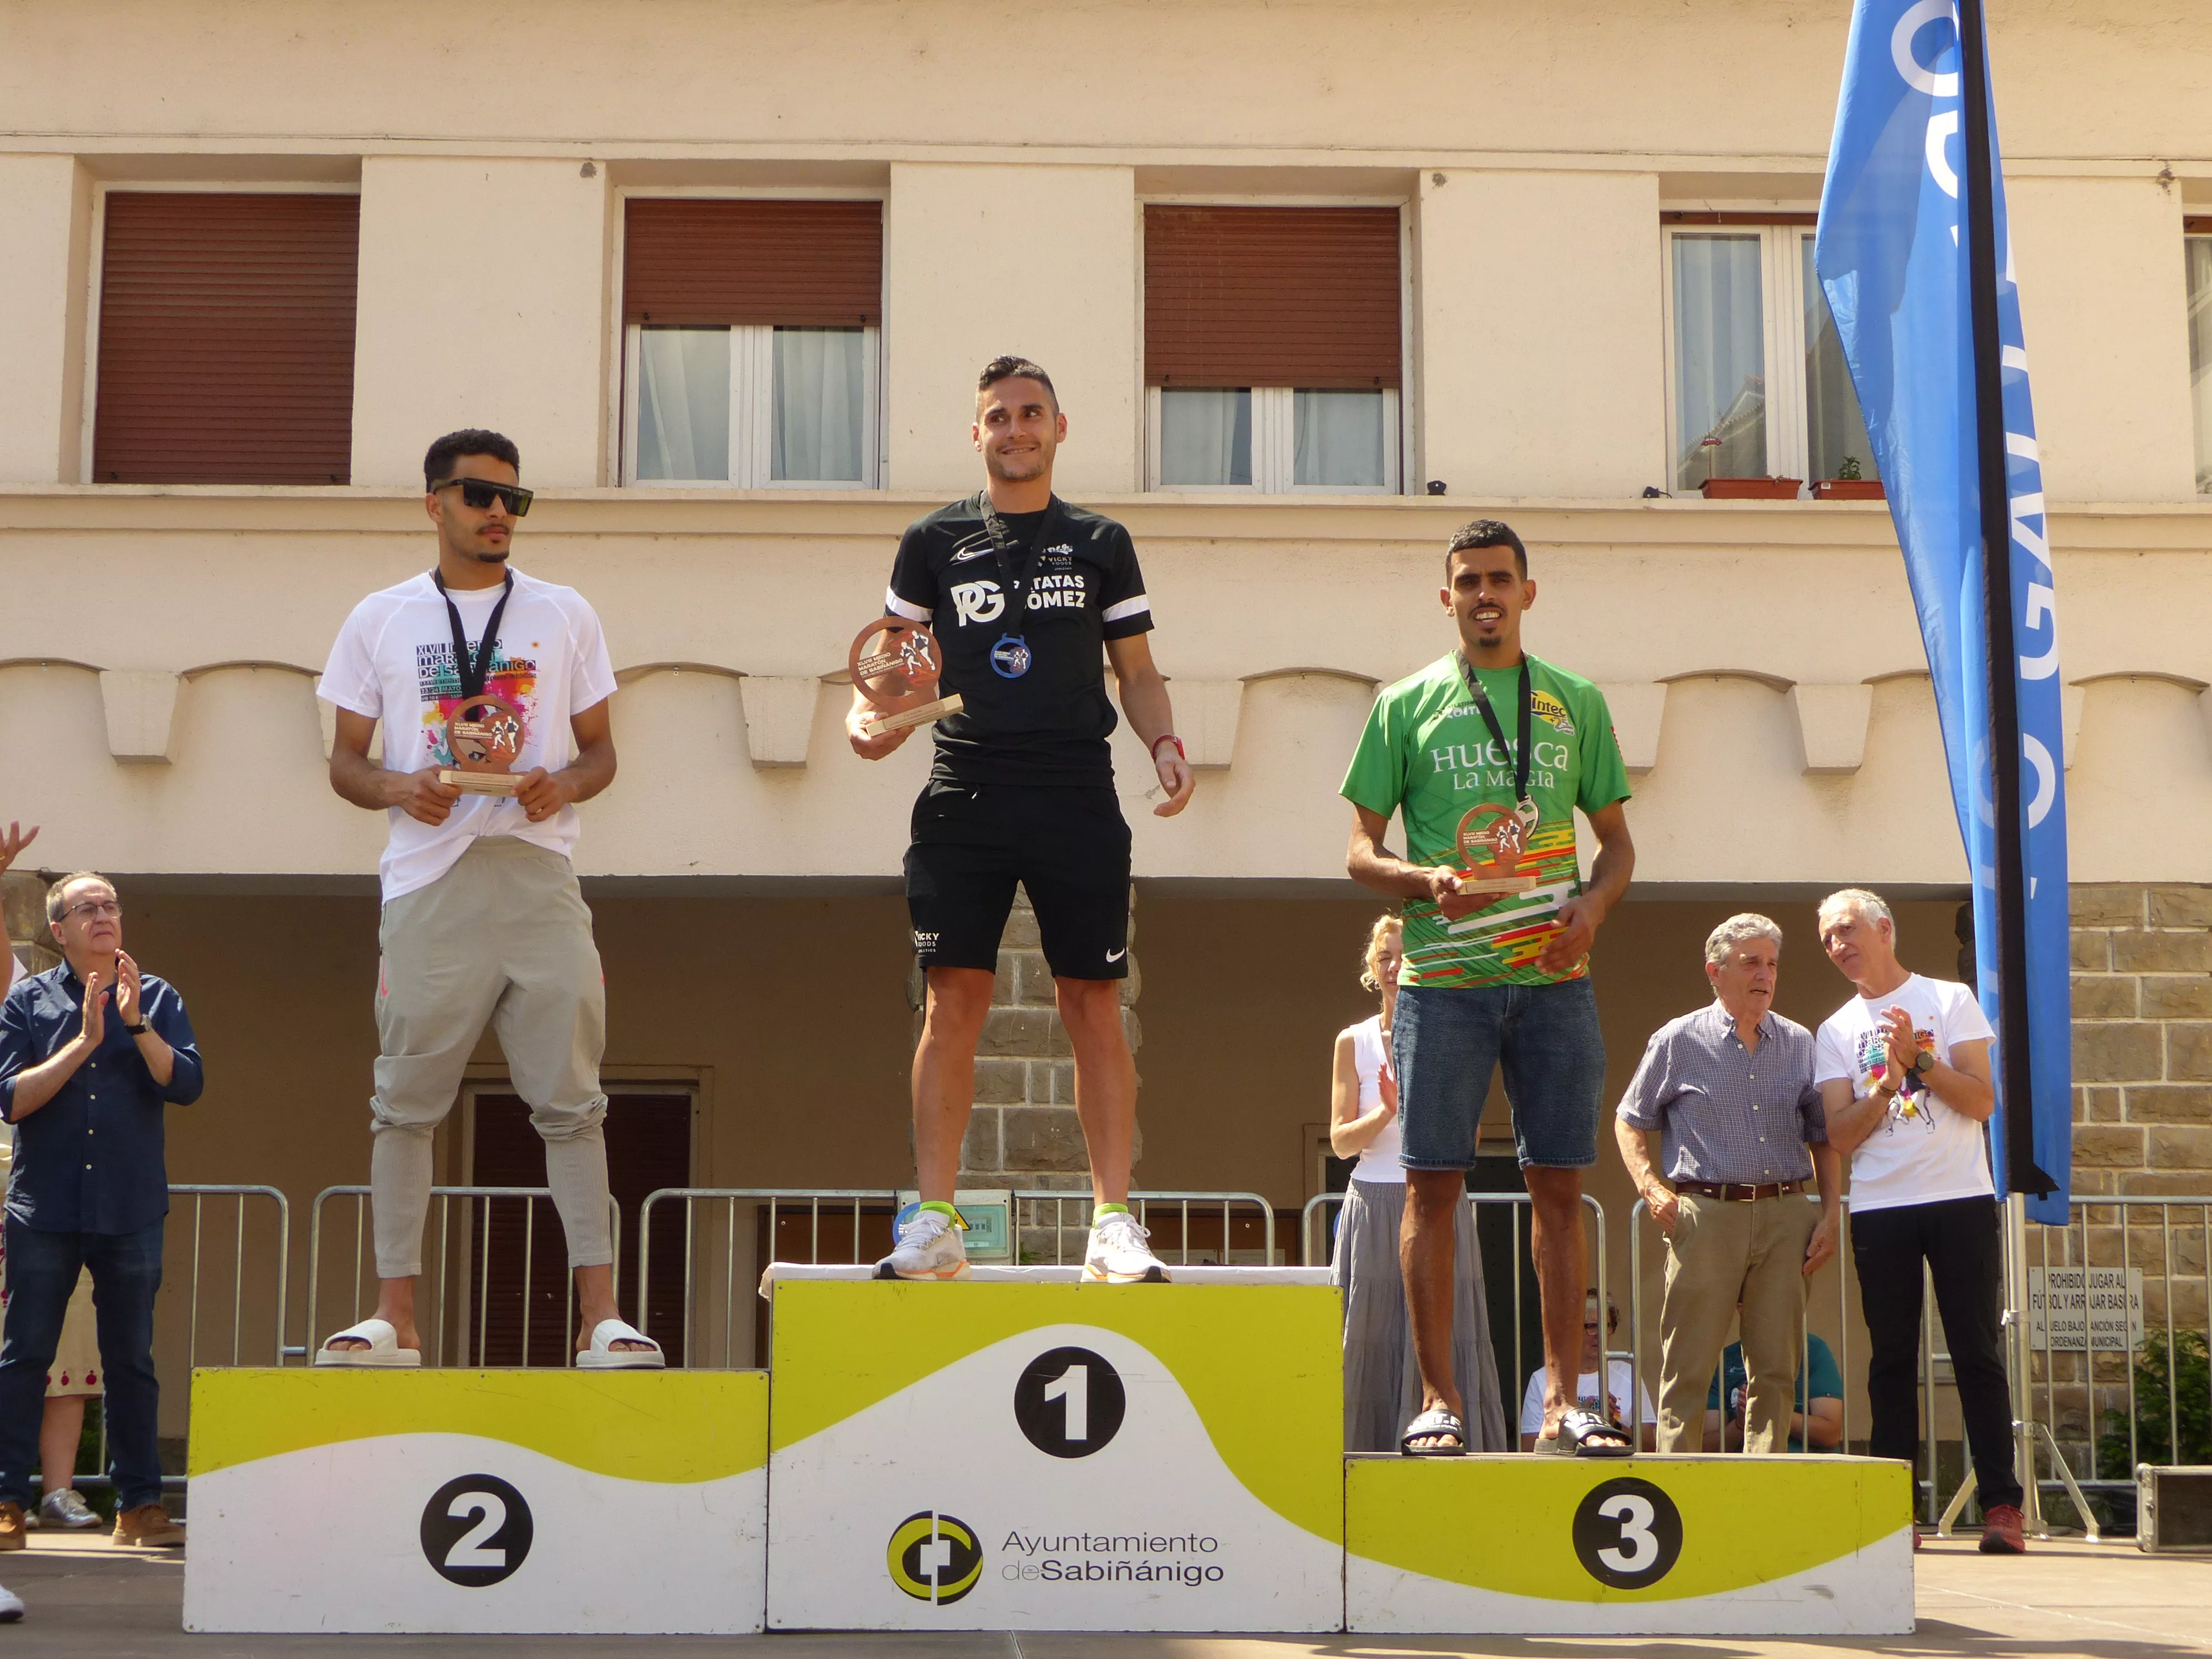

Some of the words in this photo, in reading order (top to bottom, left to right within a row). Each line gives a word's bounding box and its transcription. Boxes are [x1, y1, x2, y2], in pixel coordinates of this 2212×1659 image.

[1026, 591, 1086, 609] ÓMEZ
[2089, 1274, 2114, 1289] JUGAR
[2116, 1274, 2125, 1288] AL
[2064, 1294, 2070, 1310] Y
[2070, 1295, 2106, 1310] ARRJAR
[2108, 1295, 2140, 1310] BASRA
[2036, 1321, 2045, 1332] AL
[2051, 1321, 2067, 1332] UELO
[2068, 1321, 2085, 1332] BAJO
[2090, 1318, 2114, 1332] ANCIÓN
[1045, 1364, 1088, 1440] 1
[444, 1491, 507, 1567] 2
[1597, 1494, 1659, 1572] 3
[1001, 1531, 1218, 1556] Ayuntamiento
